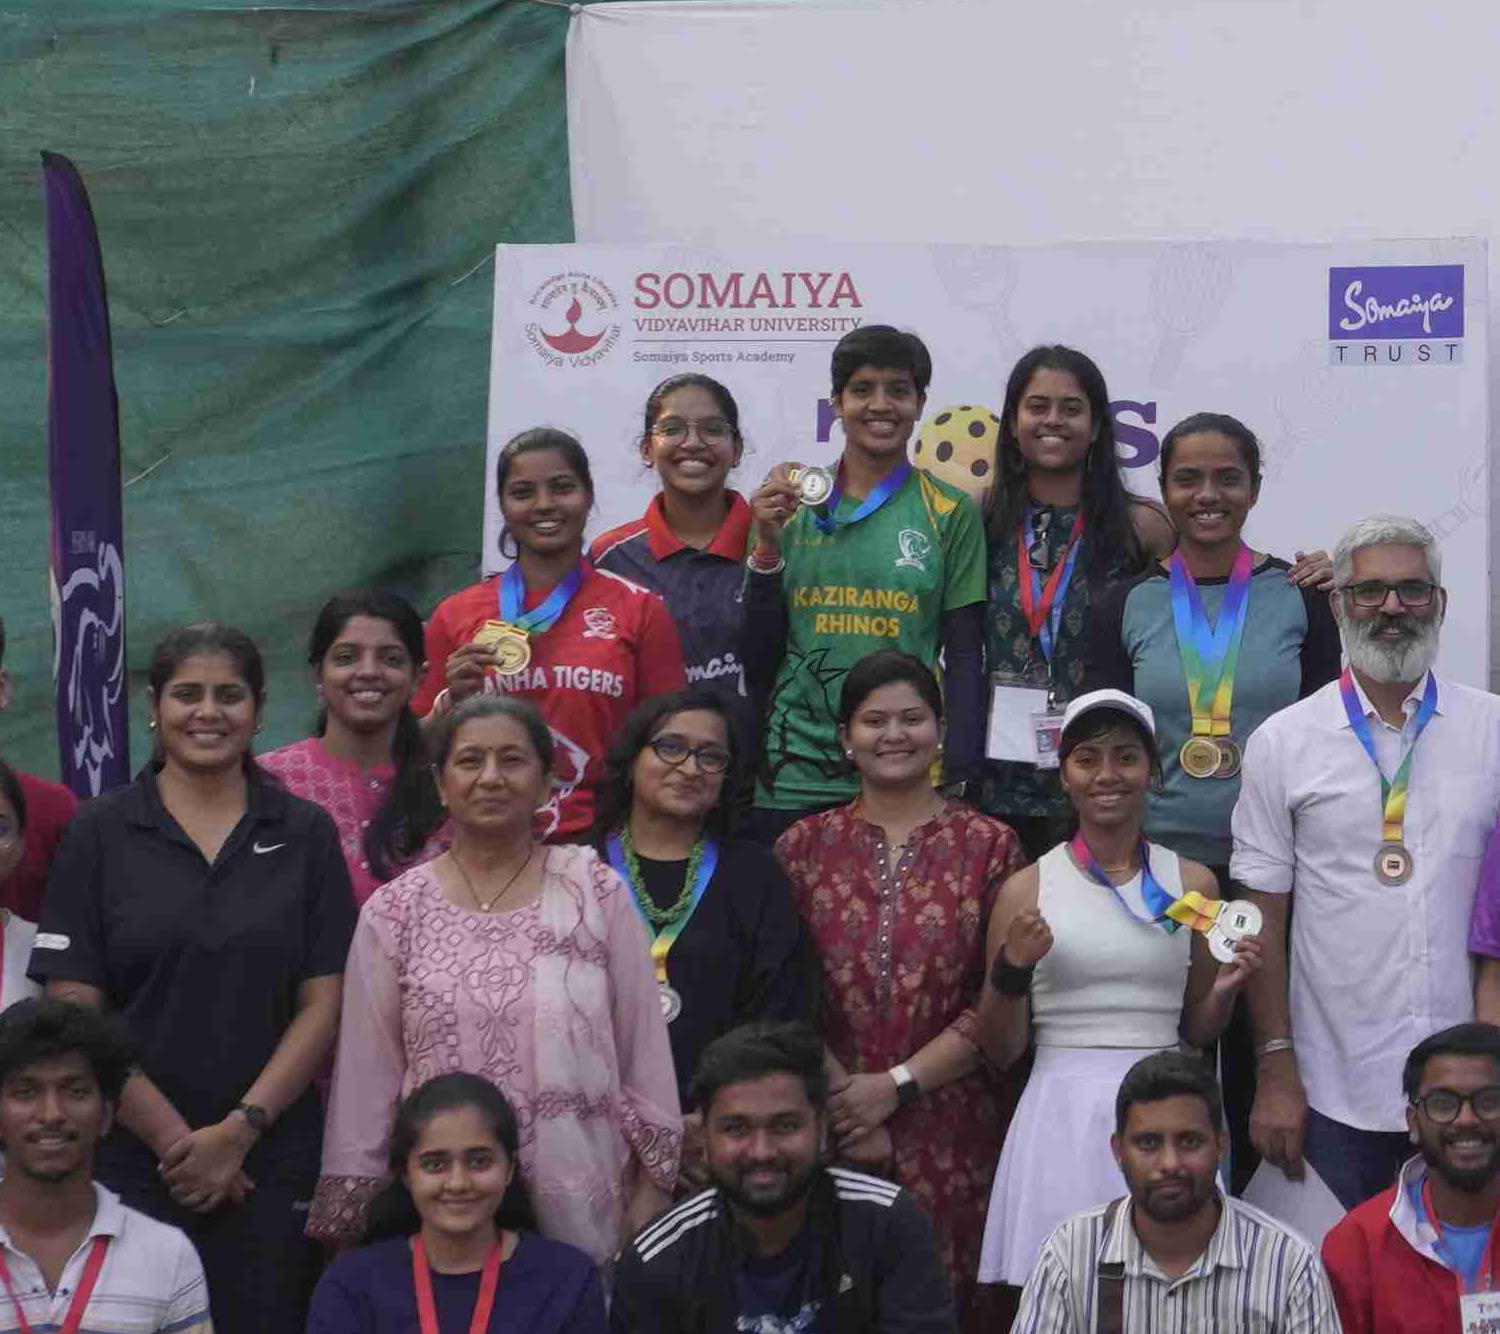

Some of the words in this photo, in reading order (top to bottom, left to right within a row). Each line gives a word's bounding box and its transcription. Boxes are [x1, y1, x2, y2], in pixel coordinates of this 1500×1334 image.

[634, 272, 863, 310] SOMAIYA
[1340, 280, 1453, 334] Somaiya
[635, 318, 744, 332] VIDYAVIHAR
[750, 318, 863, 333] UNIVERSITY
[633, 351, 688, 364] Somaiya
[691, 351, 733, 365] Sports
[737, 350, 796, 364] Academy
[1335, 343, 1457, 364] TRUST
[794, 586, 919, 615] KAZIRANGA
[814, 615, 900, 638] RHINOS
[480, 669, 549, 694] ANHA
[552, 667, 623, 697] TIGERS
